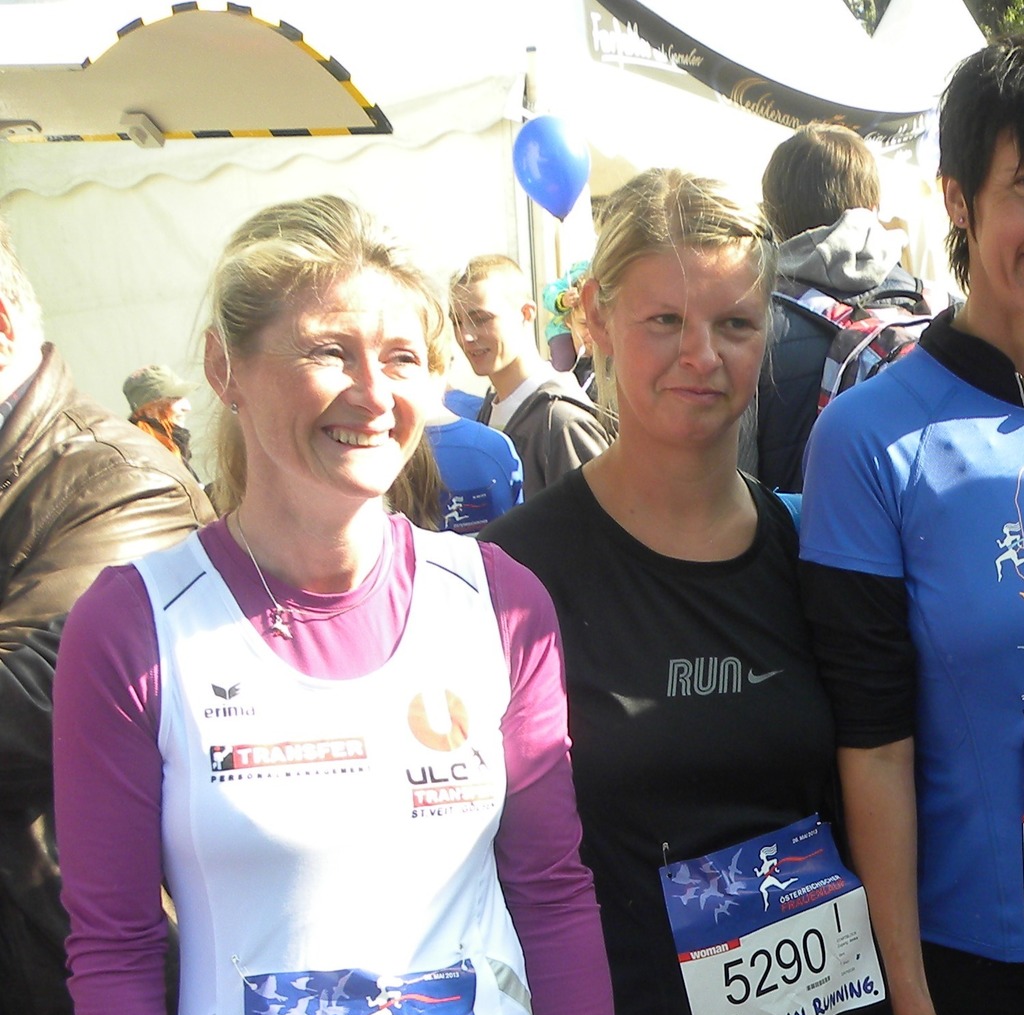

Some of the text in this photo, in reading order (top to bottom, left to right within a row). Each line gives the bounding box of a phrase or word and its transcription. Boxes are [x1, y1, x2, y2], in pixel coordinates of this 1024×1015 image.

[667, 656, 742, 697] RUN
[406, 763, 468, 785] ULC
[780, 874, 841, 903] ÖSTERREICHISCHER
[690, 942, 729, 961] woman
[723, 928, 827, 1006] 5290
